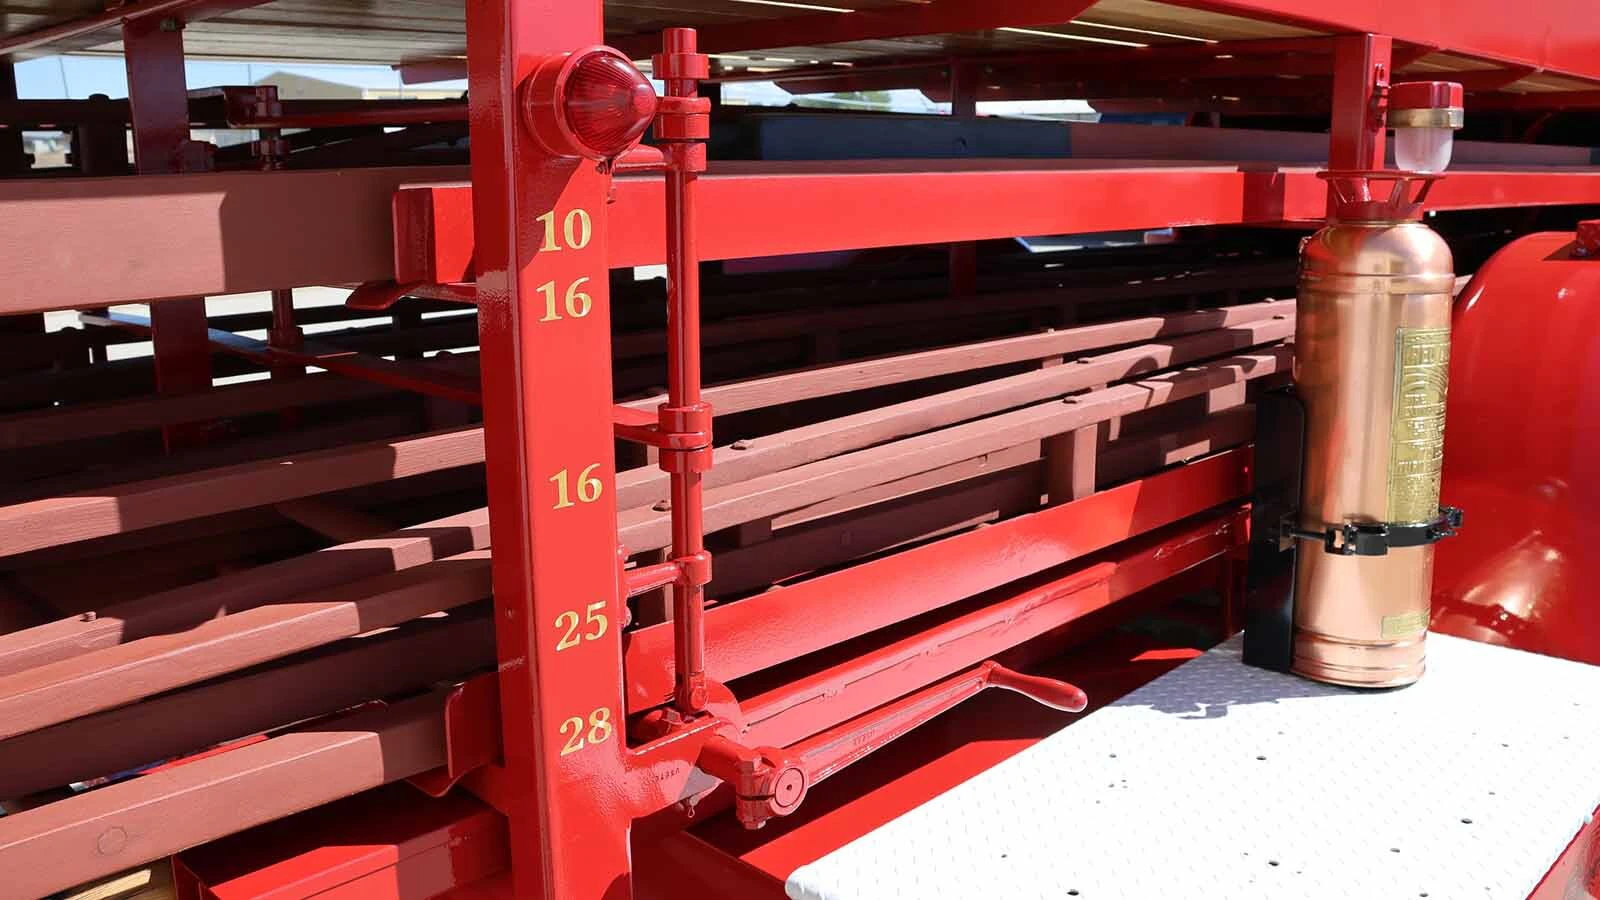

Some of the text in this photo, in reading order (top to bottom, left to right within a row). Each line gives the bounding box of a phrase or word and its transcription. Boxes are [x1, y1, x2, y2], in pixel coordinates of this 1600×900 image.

[536, 208, 592, 252] 10
[536, 276, 592, 322] 16
[549, 462, 603, 510] 16
[554, 600, 608, 652] 25
[559, 707, 613, 757] 28
